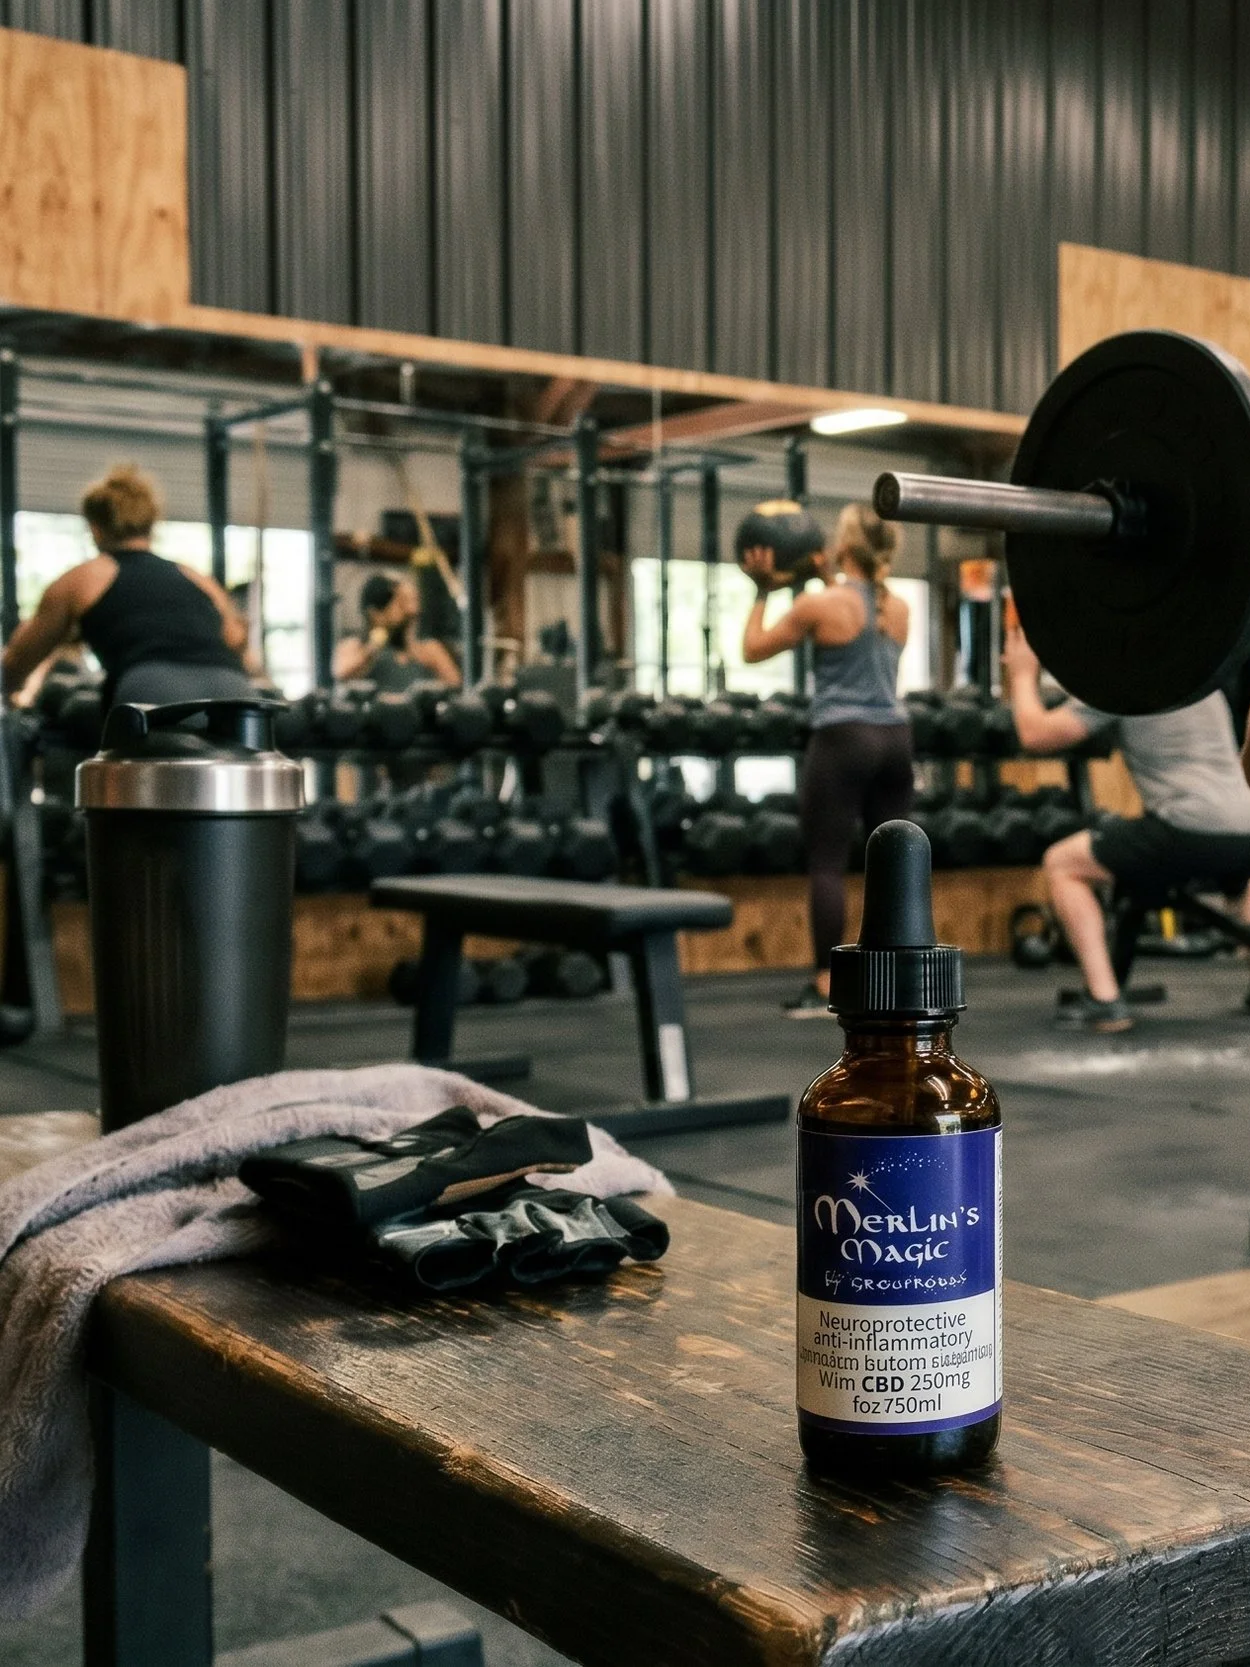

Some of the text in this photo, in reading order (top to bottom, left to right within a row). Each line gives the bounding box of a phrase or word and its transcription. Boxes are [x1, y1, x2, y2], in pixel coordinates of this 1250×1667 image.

[840, 1237, 950, 1268] MAGIC
[820, 1311, 966, 1333] Neuroprotective
[814, 1329, 973, 1351] anti-inflammatory
[819, 1369, 971, 1393] Wim CBD 250mg
